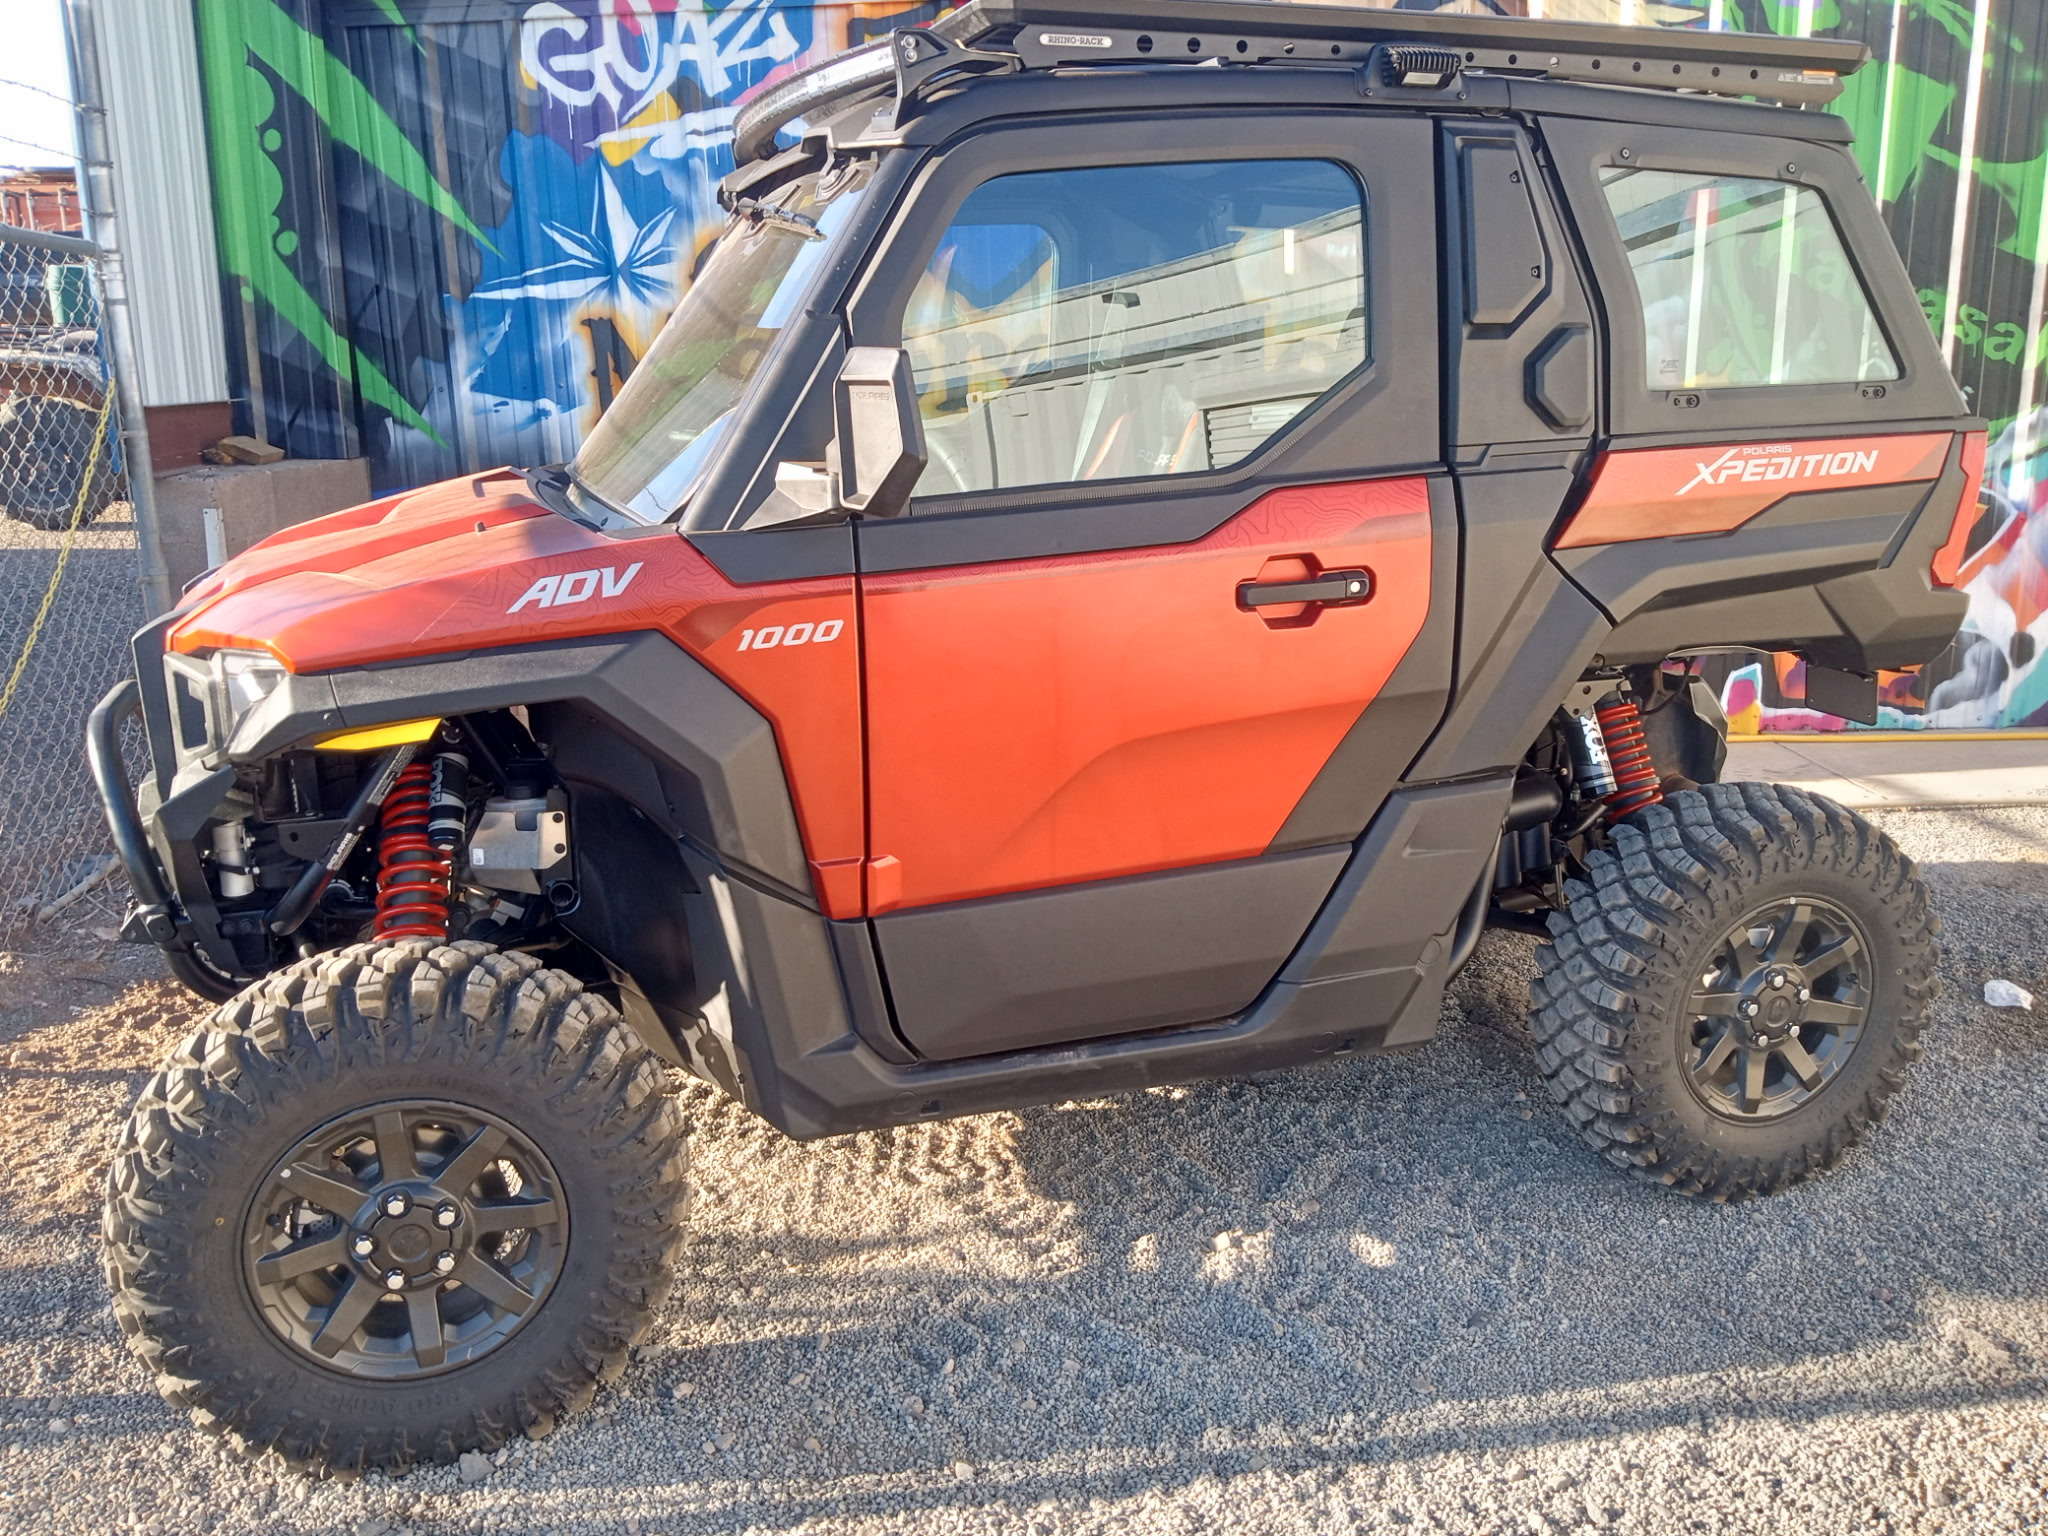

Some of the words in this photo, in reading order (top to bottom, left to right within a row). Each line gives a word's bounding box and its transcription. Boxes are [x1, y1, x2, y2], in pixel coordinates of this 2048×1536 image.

[1673, 447, 1880, 497] XPEDITION
[1742, 444, 1793, 456] POLARIS
[505, 561, 644, 614] ADV
[736, 618, 845, 652] 1000
[1579, 712, 1608, 765] FOX
[429, 757, 443, 803] FOX
